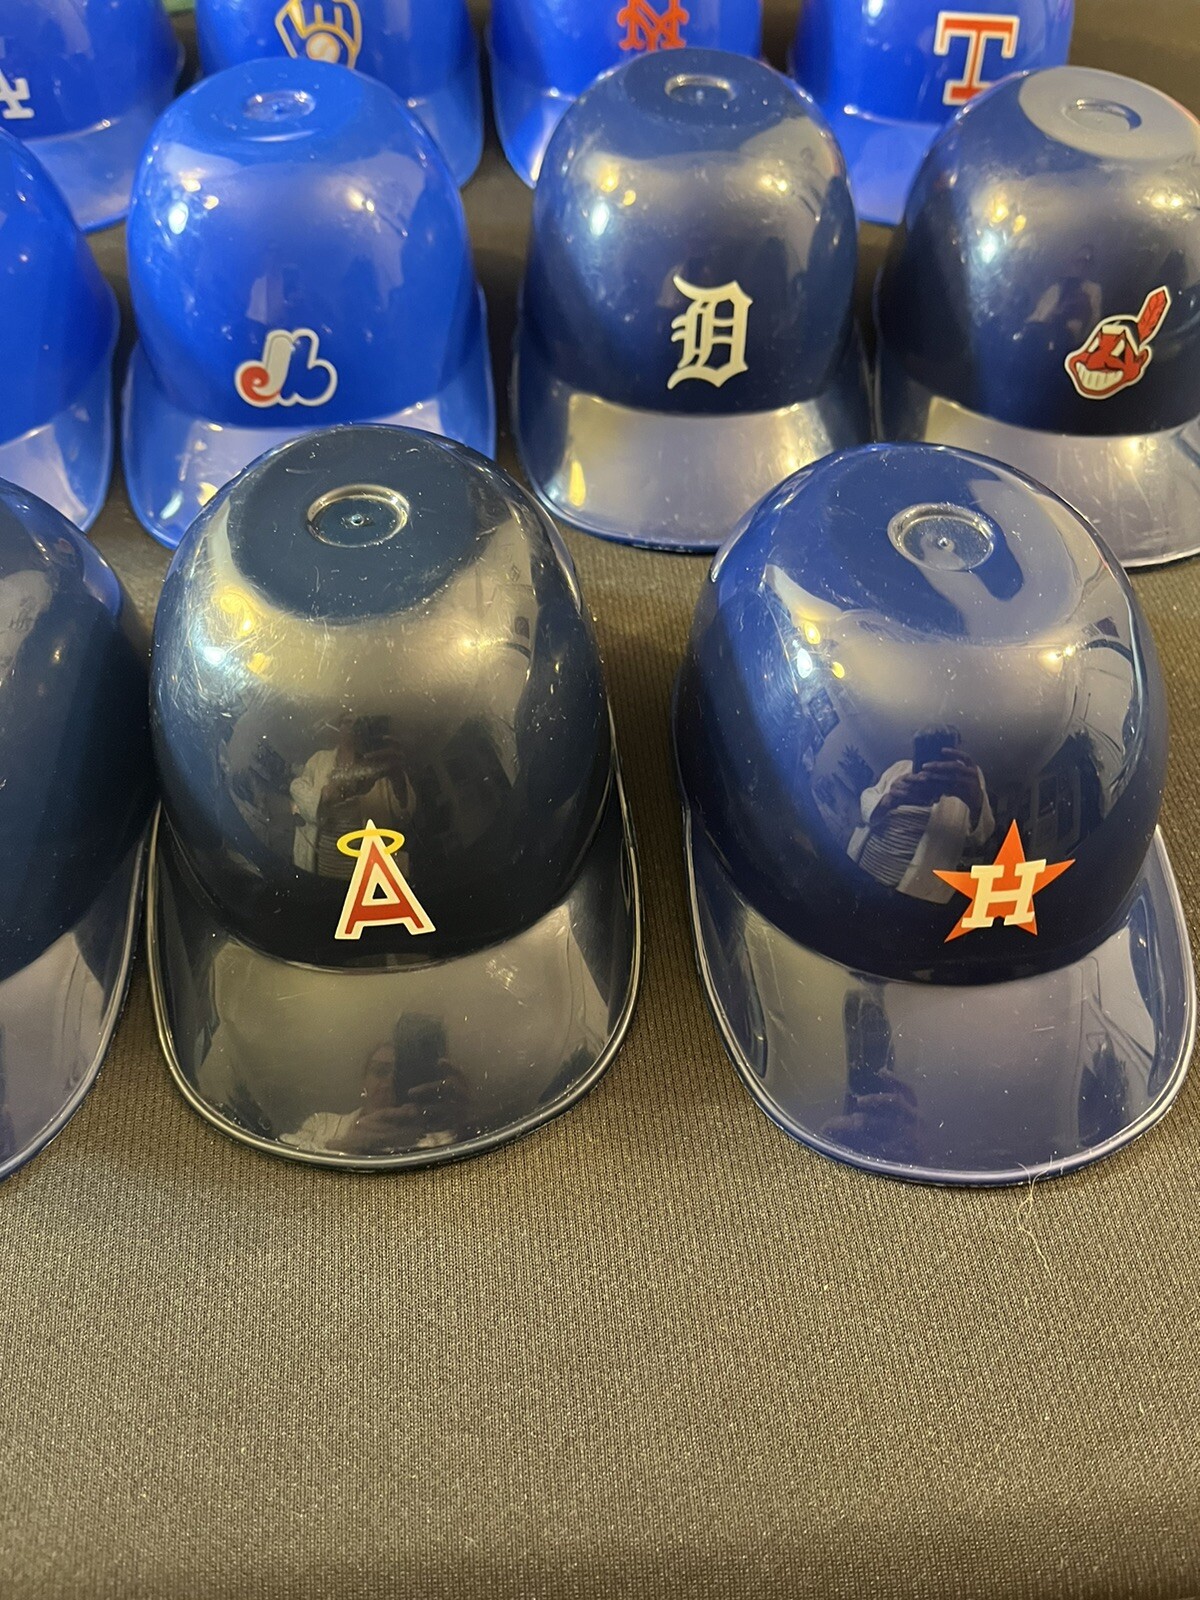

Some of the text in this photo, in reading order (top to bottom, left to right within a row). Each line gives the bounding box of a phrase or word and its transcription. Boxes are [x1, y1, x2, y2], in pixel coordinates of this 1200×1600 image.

[933, 11, 1019, 105] T
[667, 274, 753, 389] D
[334, 818, 436, 940] A
[961, 858, 1047, 928] H
